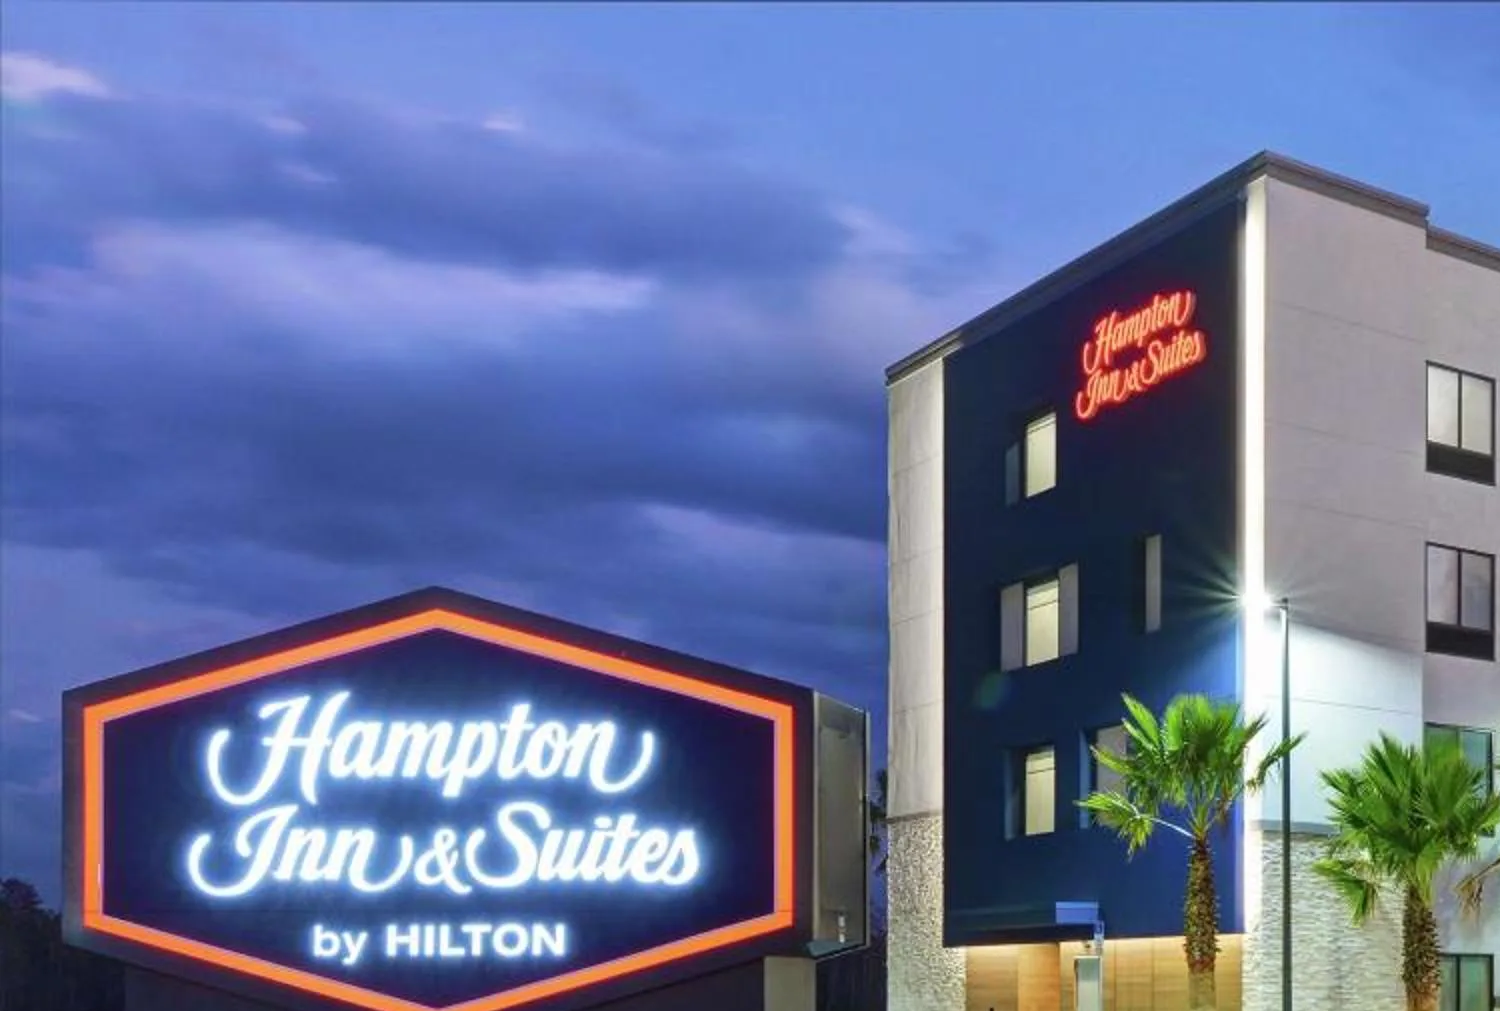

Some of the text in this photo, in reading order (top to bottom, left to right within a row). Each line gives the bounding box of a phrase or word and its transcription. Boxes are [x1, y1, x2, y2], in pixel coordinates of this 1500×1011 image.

[1075, 367, 1130, 419] Inn
[1140, 329, 1207, 384] Suites
[1083, 290, 1197, 374] Hampton
[206, 690, 655, 805] Hampton
[188, 803, 701, 897] Inn & Suites
[311, 923, 567, 965] by HILTON
